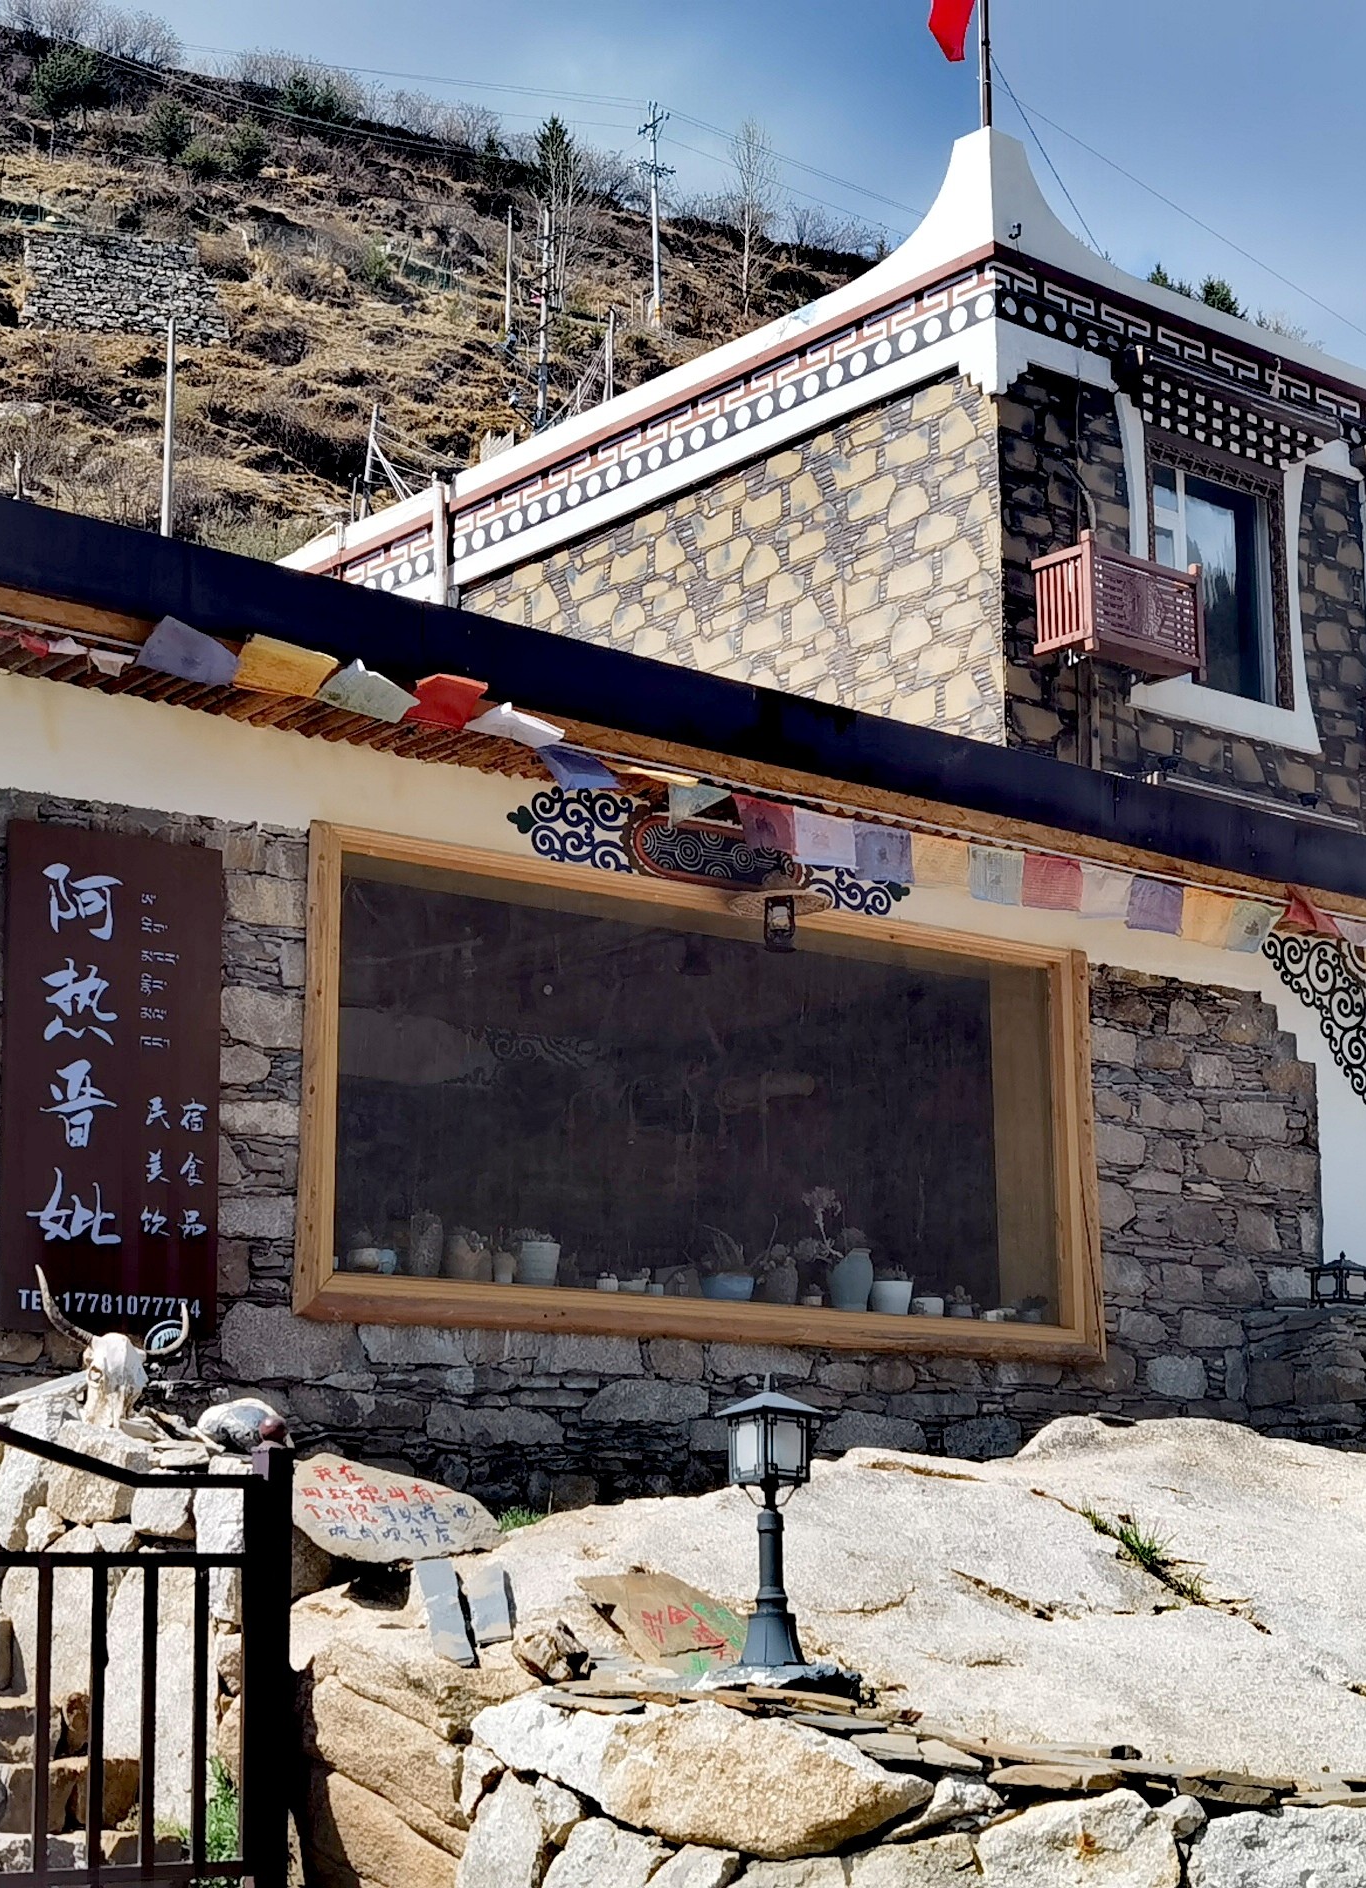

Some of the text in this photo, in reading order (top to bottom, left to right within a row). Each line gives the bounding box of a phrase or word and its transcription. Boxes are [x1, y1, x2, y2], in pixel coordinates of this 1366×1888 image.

[145, 1096, 208, 1132] 民宿
[145, 1149, 205, 1187] 美食
[140, 1205, 208, 1239] 饮品
[18, 1288, 201, 1319] TE:17781077774
